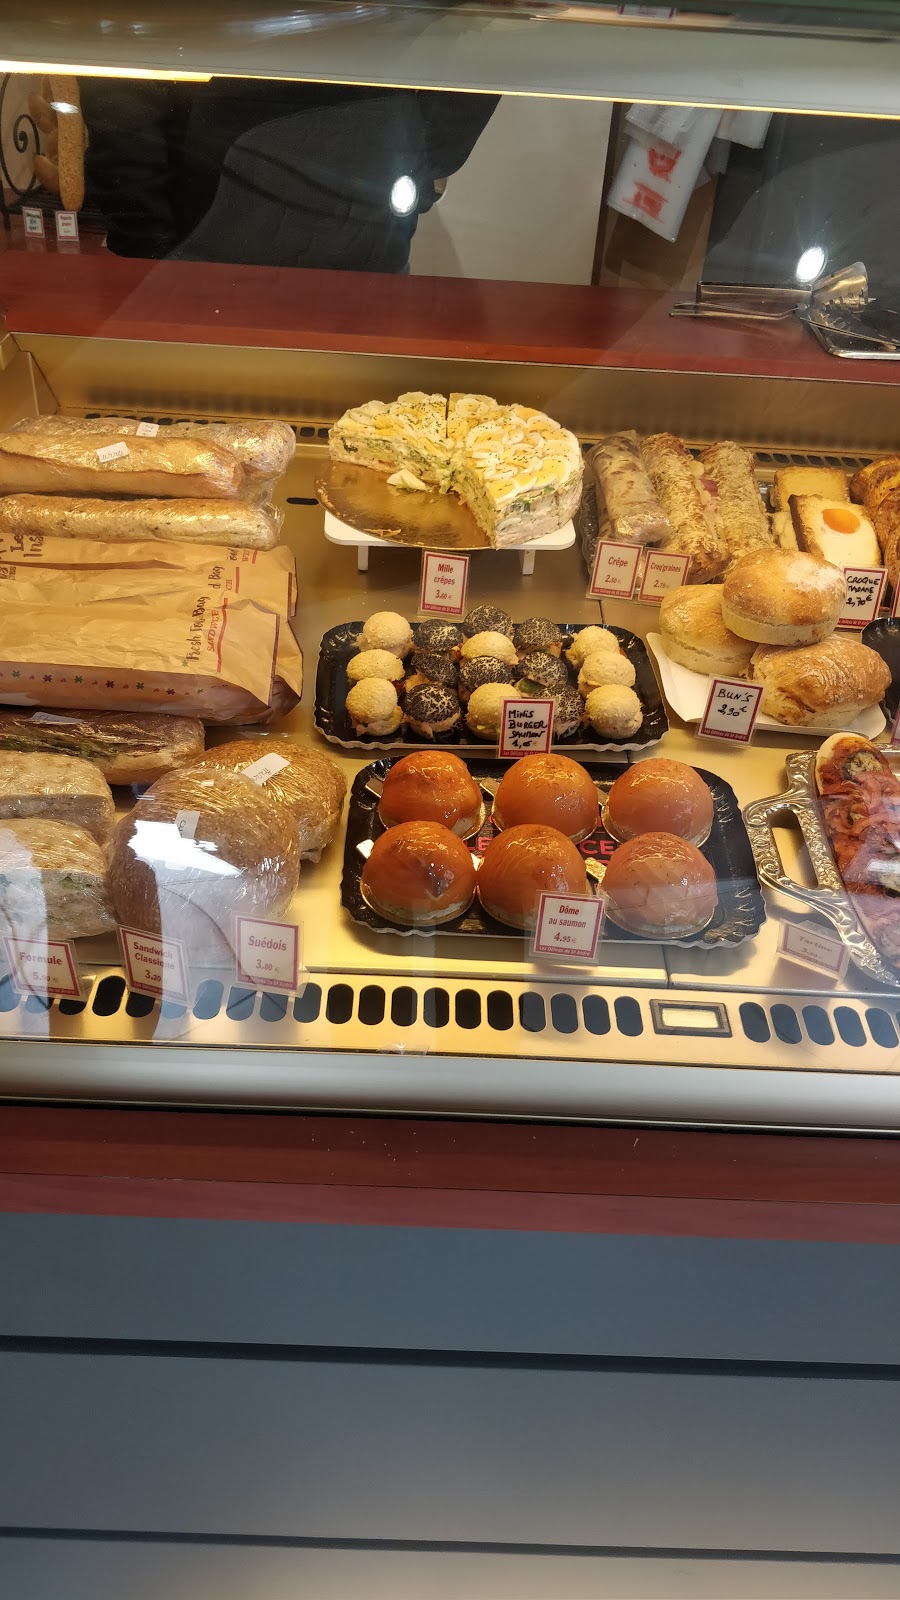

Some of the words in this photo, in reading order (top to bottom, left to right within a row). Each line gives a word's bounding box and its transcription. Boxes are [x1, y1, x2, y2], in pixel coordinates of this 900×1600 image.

[437, 563, 454, 573] Mille
[608, 556, 629, 568] Crêpe
[650, 561, 681, 573] Croq'graines
[208, 566, 225, 580] Bag
[433, 575, 456, 585] crêpes
[847, 576, 881, 585] CROQUE
[192, 596, 211, 618] Bag
[186, 635, 202, 660] Fresh
[716, 688, 754, 702] BUN'S
[508, 719, 548, 729] BURGER
[559, 904, 580, 915] Dôme
[548, 917, 558, 925] au
[559, 918, 587, 929] saumon
[247, 935, 287, 951] Suédois
[799, 935, 833, 953] Tartine
[133, 941, 173, 960] Sandwich
[19, 951, 62, 966] Formule
[134, 952, 175, 970] Classique
[255, 958, 273, 971] 3.80
[144, 969, 162, 982] 3.20
